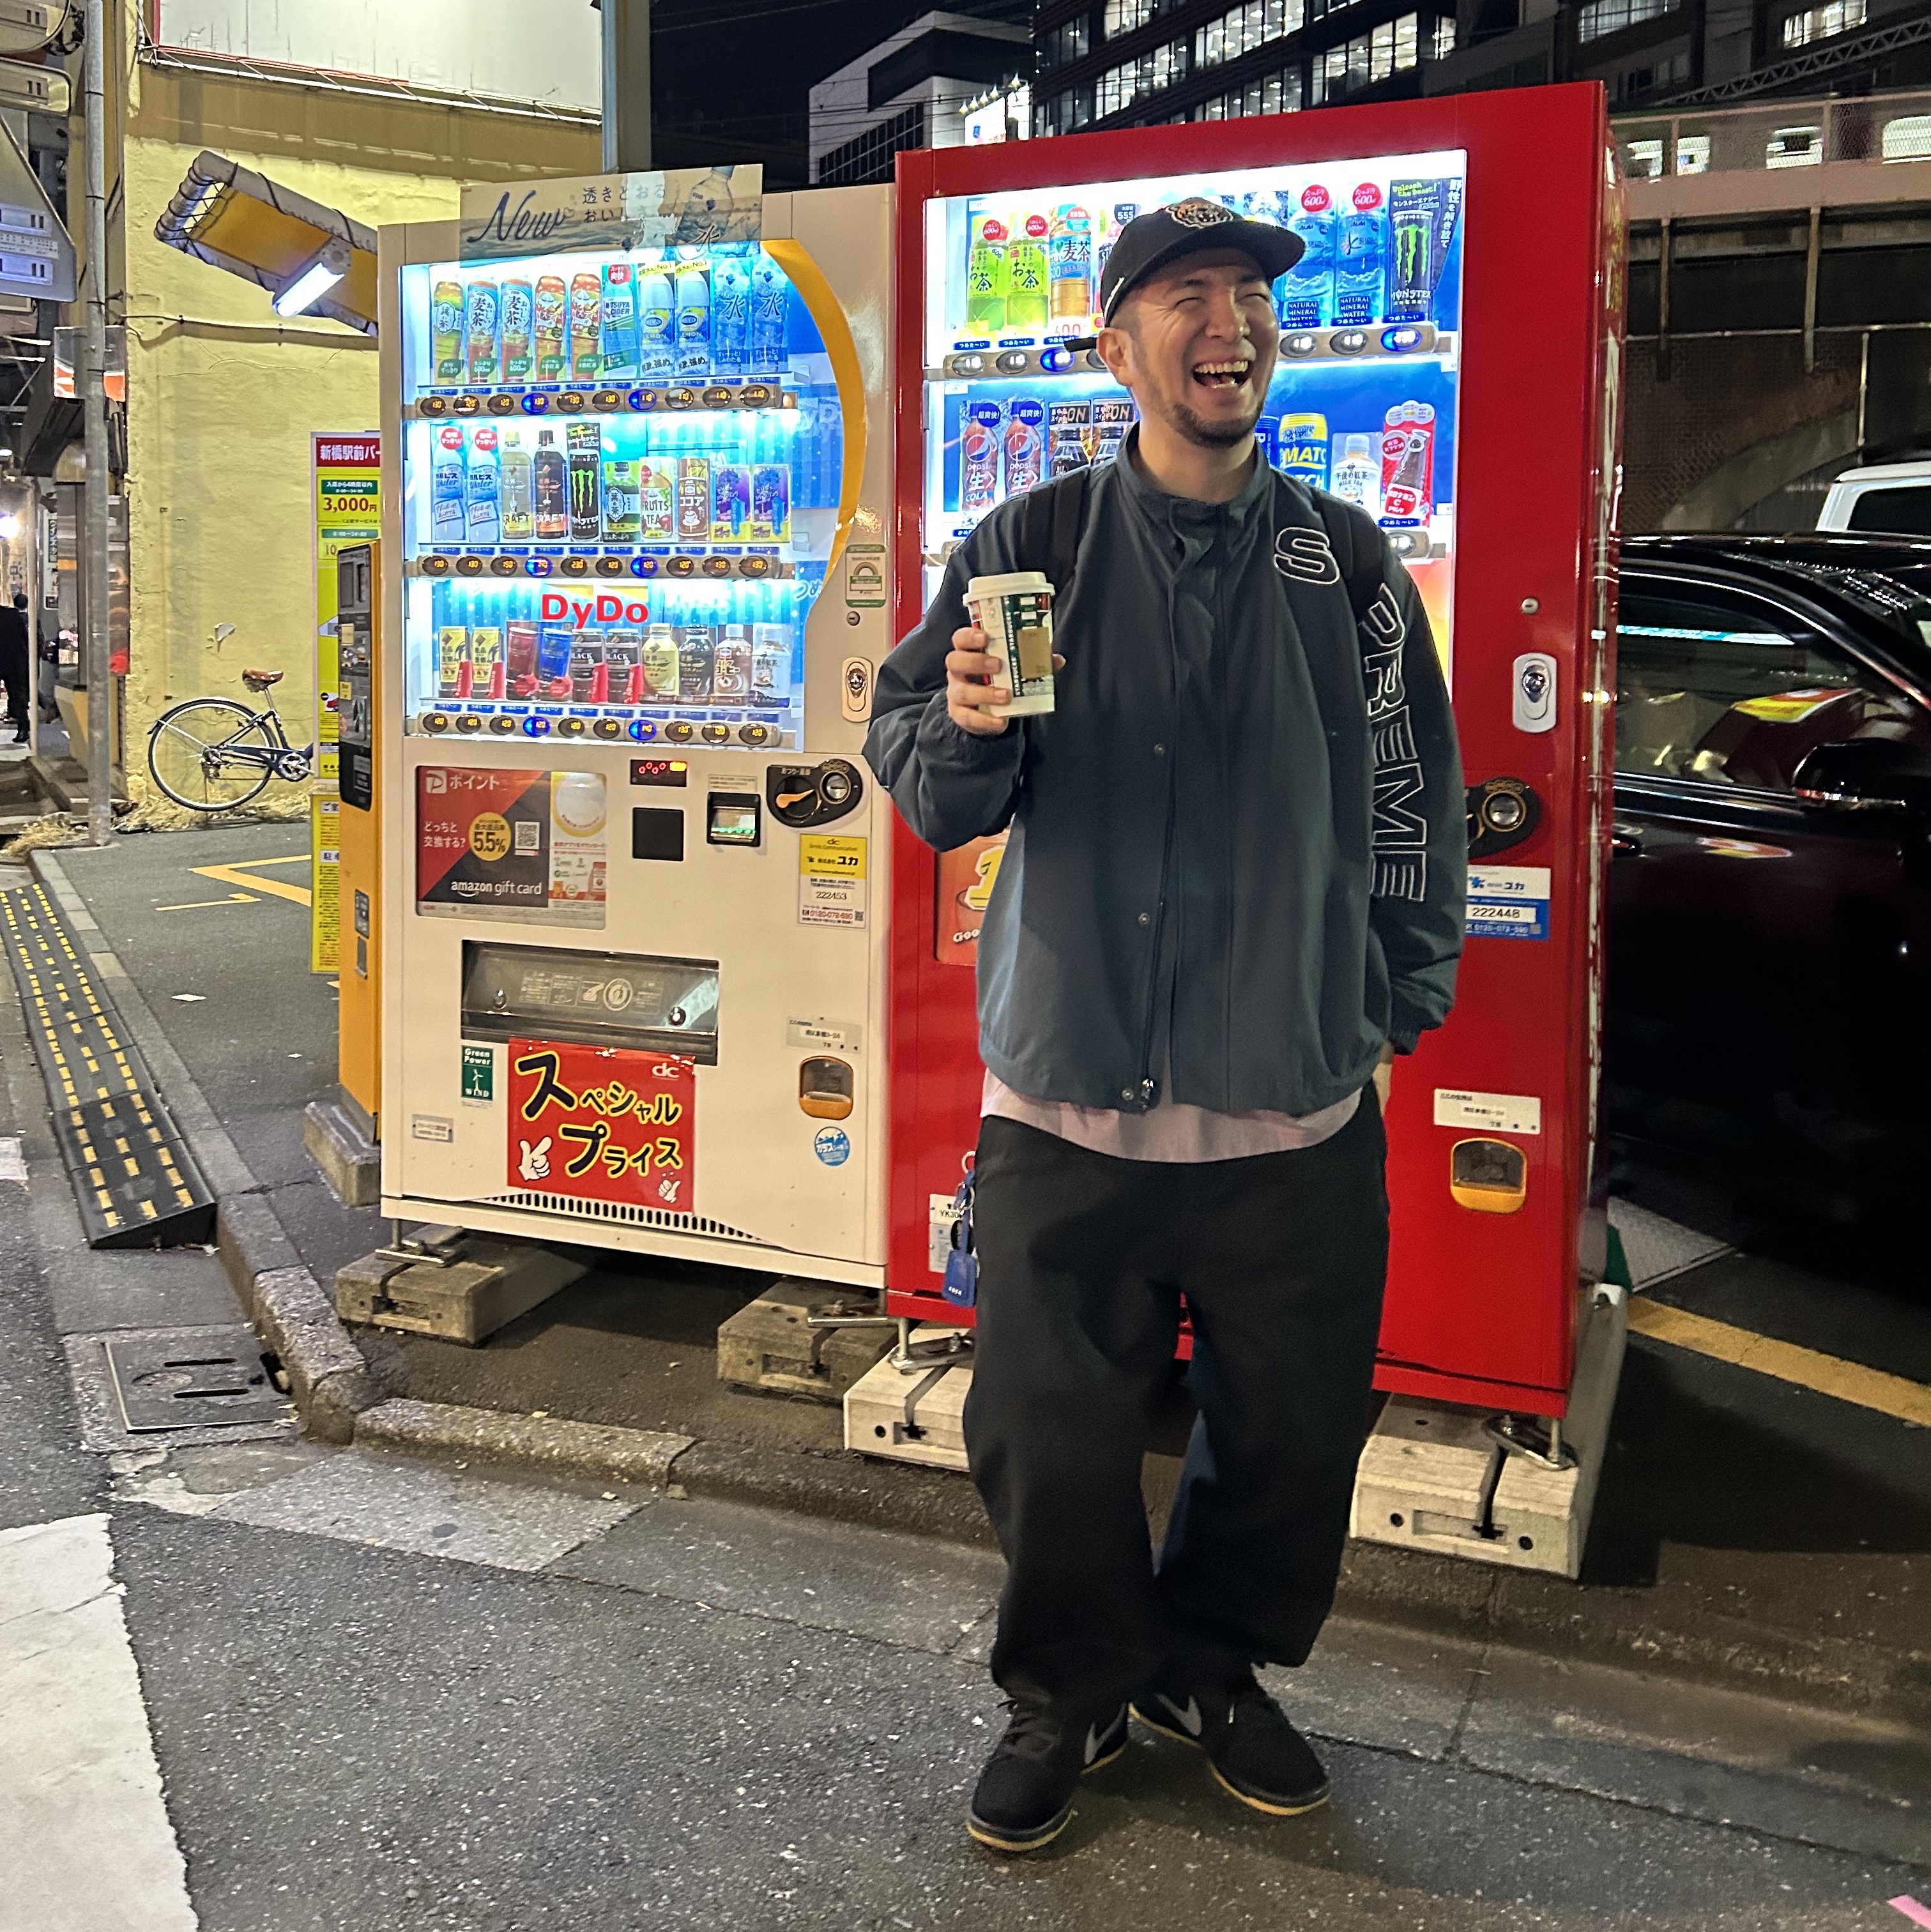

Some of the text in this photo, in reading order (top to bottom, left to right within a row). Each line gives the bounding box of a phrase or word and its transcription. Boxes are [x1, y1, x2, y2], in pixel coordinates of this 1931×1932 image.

[582, 185, 666, 205] 透きとおる
[467, 190, 573, 243] New
[1118, 211, 1134, 220] 555
[991, 248, 1002, 259] 600
[1037, 245, 1047, 254] 600
[1064, 240, 1090, 263] 麦茶
[1012, 258, 1039, 289] お茶
[506, 295, 522, 325] 麦茶
[720, 294, 745, 320] 水
[757, 291, 783, 318] 水
[472, 297, 487, 326] 麦茶
[717, 391, 727, 399] 110
[1067, 407, 1086, 422] ON
[1111, 404, 1131, 420] ON
[1285, 446, 1327, 463] MATC
[967, 463, 988, 473] pepsi
[1009, 462, 1032, 472] pepsi
[1336, 471, 1368, 480] 午後の紅茶
[680, 495, 705, 507] ココア
[965, 491, 988, 501] COLA
[323, 497, 378, 513] 3,000円
[642, 499, 669, 511] FRUITS
[503, 513, 530, 524] CRAFT
[536, 513, 565, 523] CRAFT
[646, 513, 660, 525] TEA
[542, 593, 649, 630] DyDo
[449, 774, 500, 791] ポイント
[424, 821, 458, 833] どっちと
[450, 880, 542, 896] amazon gift card
[816, 891, 848, 900] 222453
[1472, 908, 1522, 918] 222448
[464, 1047, 491, 1058] Green
[464, 1056, 491, 1066] Power
[652, 1063, 680, 1078] dc
[464, 1088, 490, 1099] WIND
[515, 1051, 683, 1125] スペシャル
[559, 1122, 683, 1178] プライス
